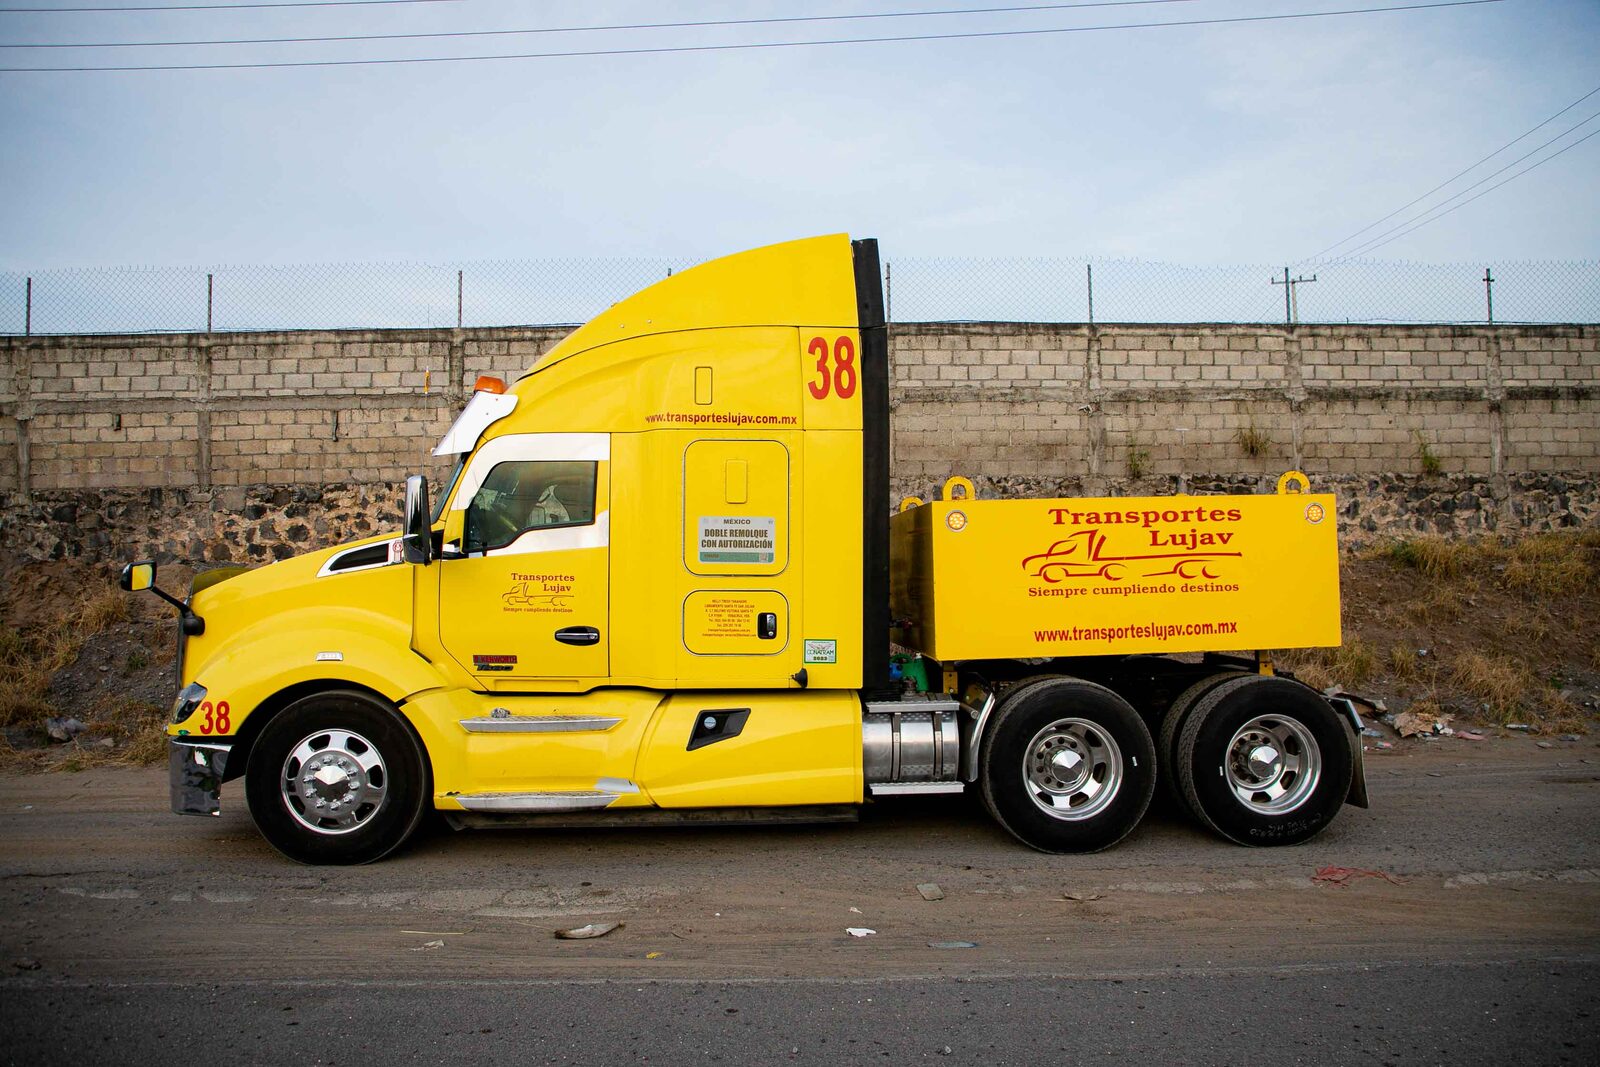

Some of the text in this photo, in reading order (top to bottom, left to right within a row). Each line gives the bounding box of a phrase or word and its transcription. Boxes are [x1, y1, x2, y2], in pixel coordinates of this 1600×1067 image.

[807, 335, 857, 401] 38
[645, 411, 797, 426] www.transporteslujav.com.mx
[723, 517, 751, 525] MÉXICO
[1048, 506, 1243, 529] Transportes
[704, 528, 769, 539] DOBLE REMOLQUE
[1148, 529, 1234, 551] Lujav
[701, 538, 773, 549] CON AUTORIZACIÓN
[510, 572, 576, 583] Transportes
[543, 583, 572, 594] Lujav
[1028, 582, 1240, 598] Siempre cumpliendo destinos
[1034, 621, 1238, 643] www.transporteslujav.com.mx
[199, 700, 231, 735] 38
